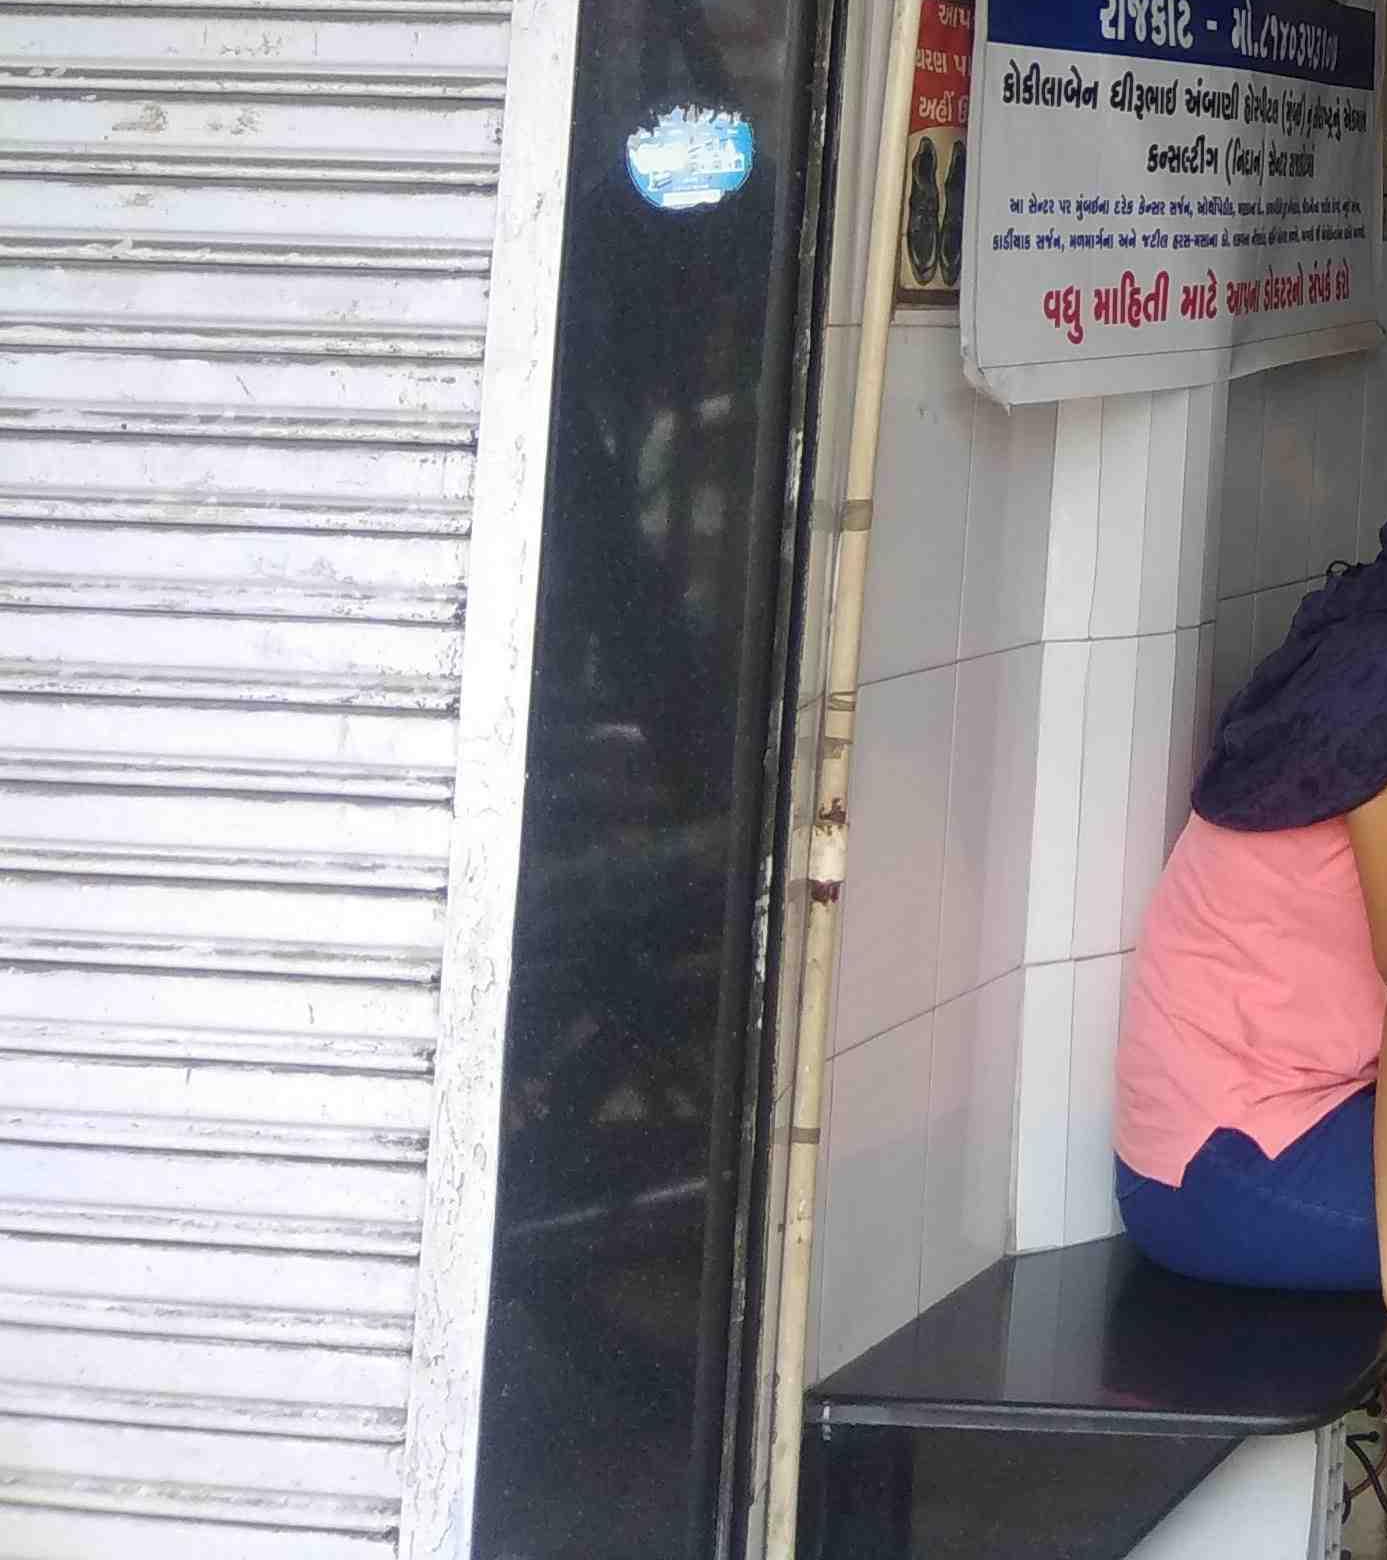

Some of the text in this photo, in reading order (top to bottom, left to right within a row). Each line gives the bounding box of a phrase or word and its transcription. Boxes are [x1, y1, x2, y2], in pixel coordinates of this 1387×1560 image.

[1002, 58, 1099, 110] કોકીલાબેન
[1042, 284, 1084, 345] વધુ
[1094, 269, 1169, 328] માહિતી
[1181, 268, 1218, 320] માટે
